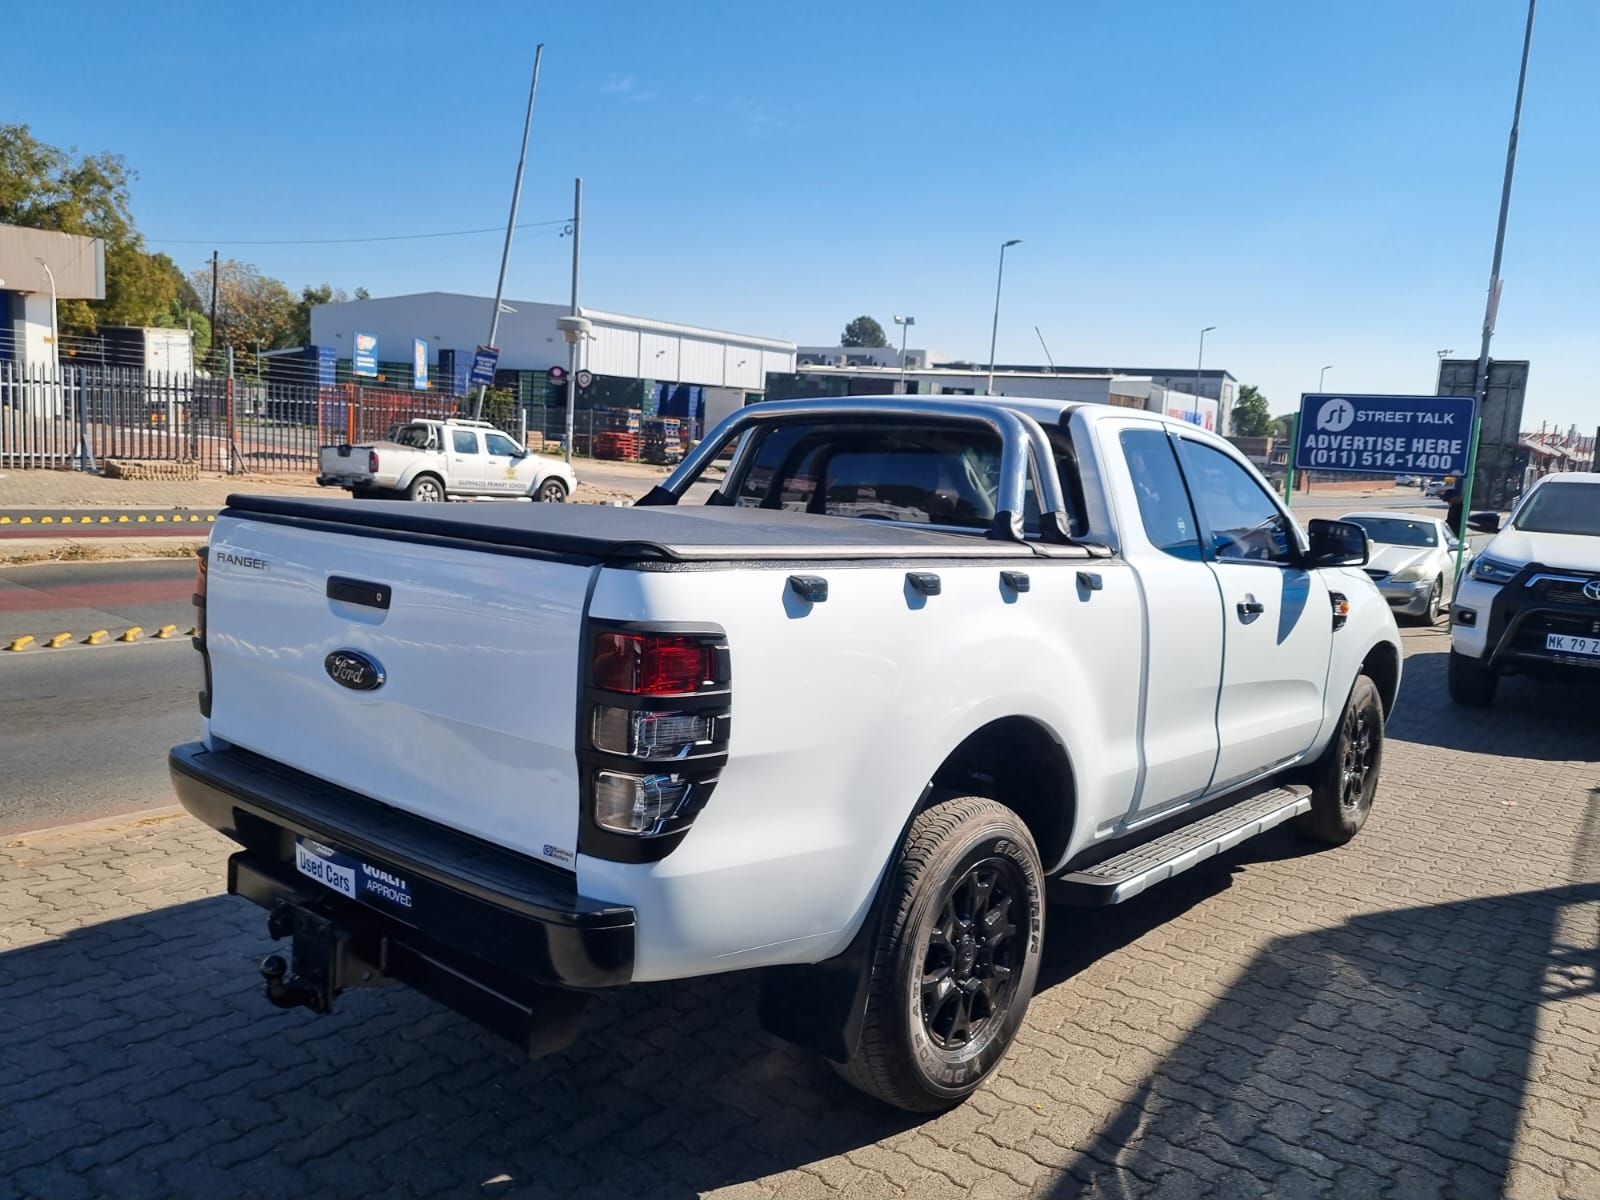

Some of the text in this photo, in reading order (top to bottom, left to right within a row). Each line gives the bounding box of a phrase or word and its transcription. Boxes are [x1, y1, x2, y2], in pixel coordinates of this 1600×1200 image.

[1356, 410, 1455, 425] STREET TALK
[1305, 434, 1462, 455] ADVERTISE HERE
[1310, 449, 1453, 470] (011) 514-1400
[216, 552, 273, 571] RANGER
[1570, 638, 1586, 652] 79
[332, 656, 364, 684] Ford
[299, 849, 323, 878] Used
[326, 864, 350, 892] Cars
[366, 879, 413, 908] APPROVED
